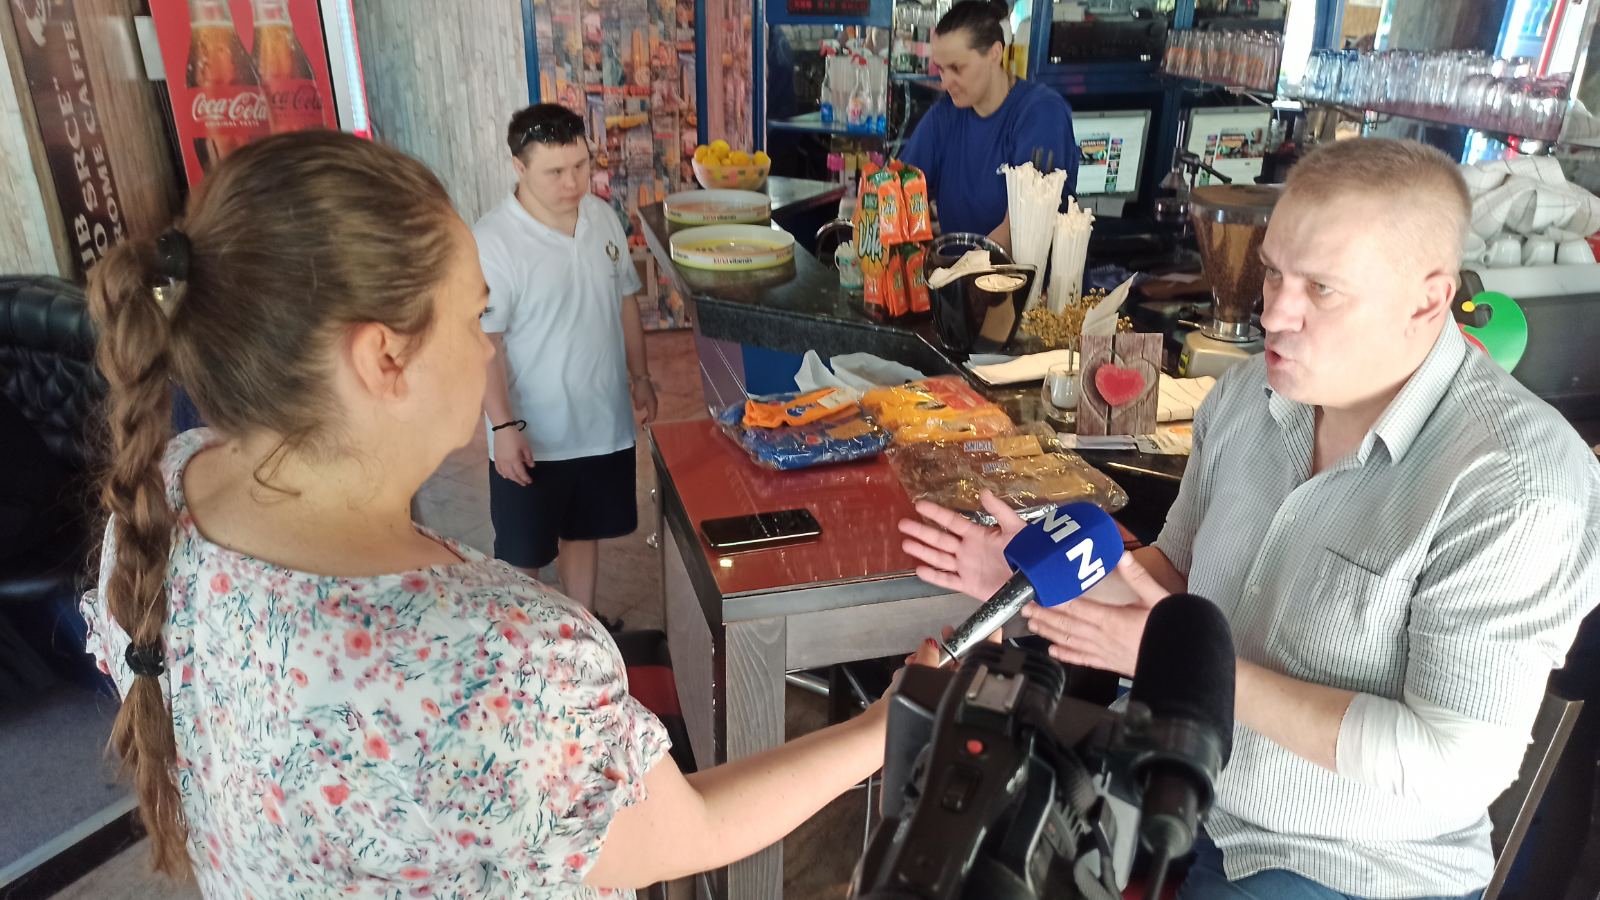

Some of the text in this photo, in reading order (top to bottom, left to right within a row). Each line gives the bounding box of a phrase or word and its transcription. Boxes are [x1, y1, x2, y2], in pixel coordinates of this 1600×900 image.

[62, 20, 97, 134] CAFFE
[192, 91, 268, 121] Coca-Cola
[1065, 537, 1106, 591] N1
